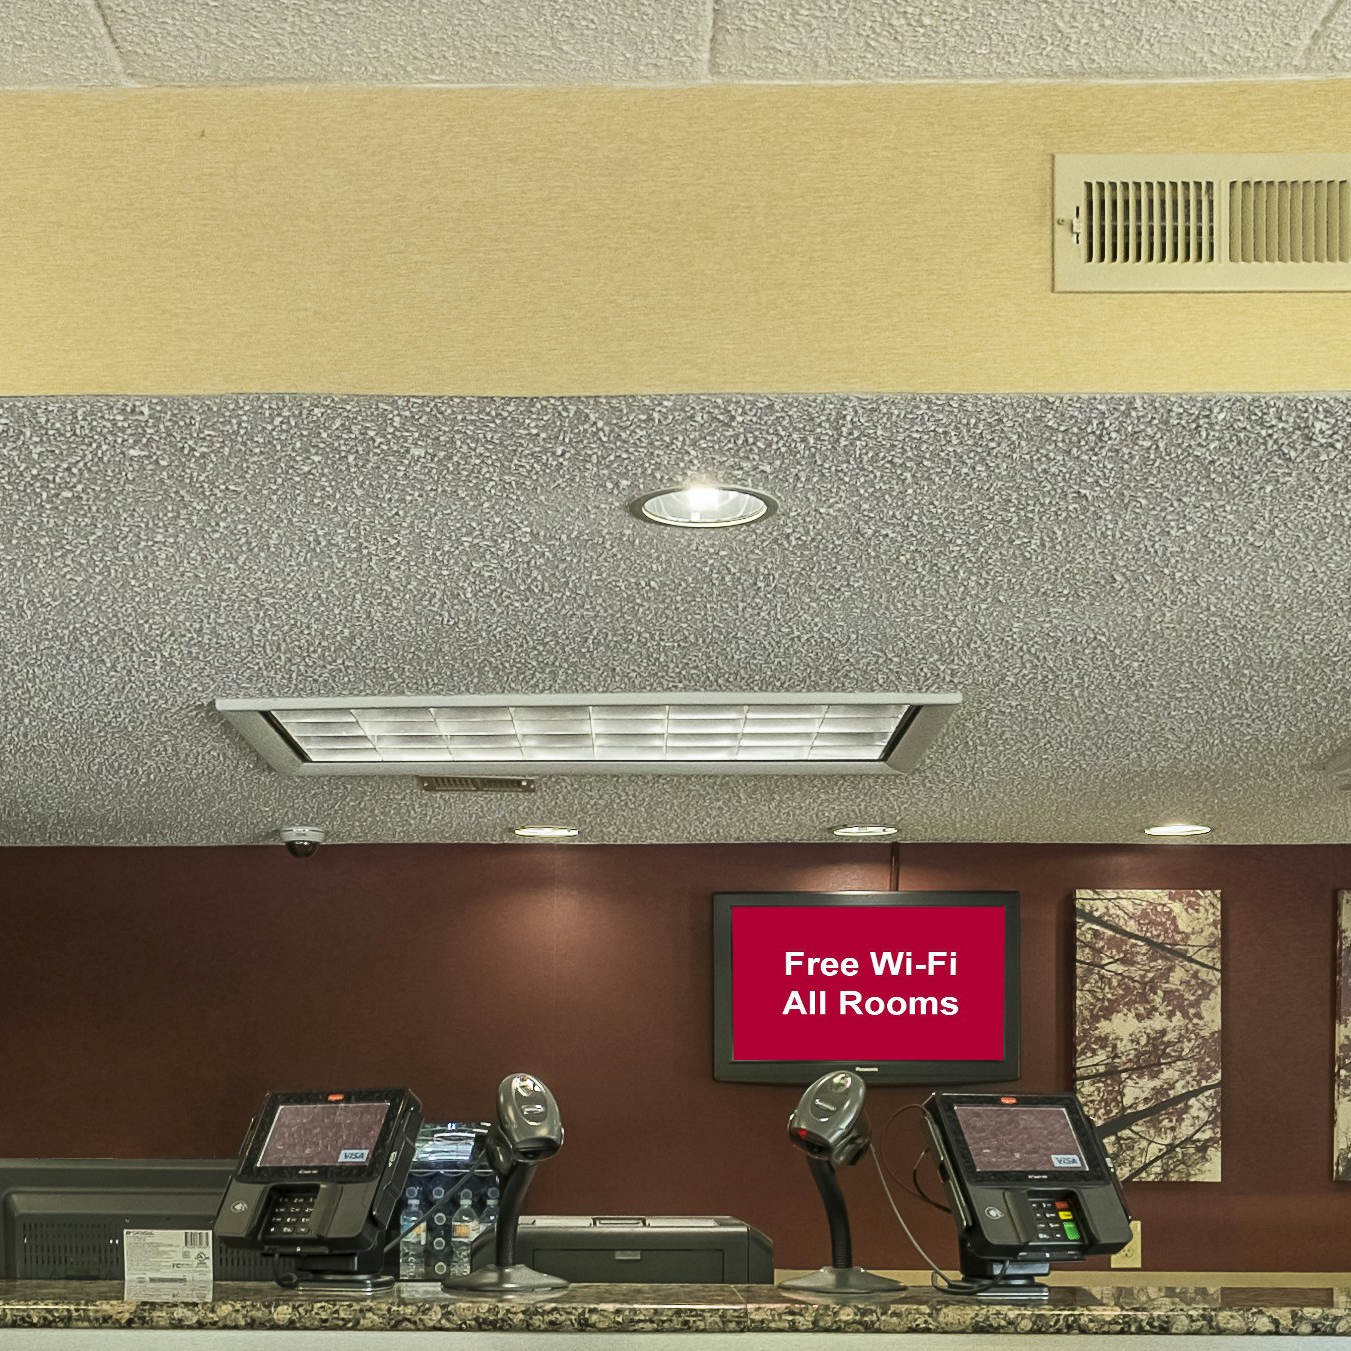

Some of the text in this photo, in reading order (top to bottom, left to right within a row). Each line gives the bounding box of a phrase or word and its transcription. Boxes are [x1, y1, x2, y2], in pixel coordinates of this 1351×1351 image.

[785, 951, 958, 977] Free Wi-Fi
[782, 990, 959, 1016] All Rooms
[343, 1152, 365, 1160] VISA
[1055, 1157, 1078, 1165] VISA
